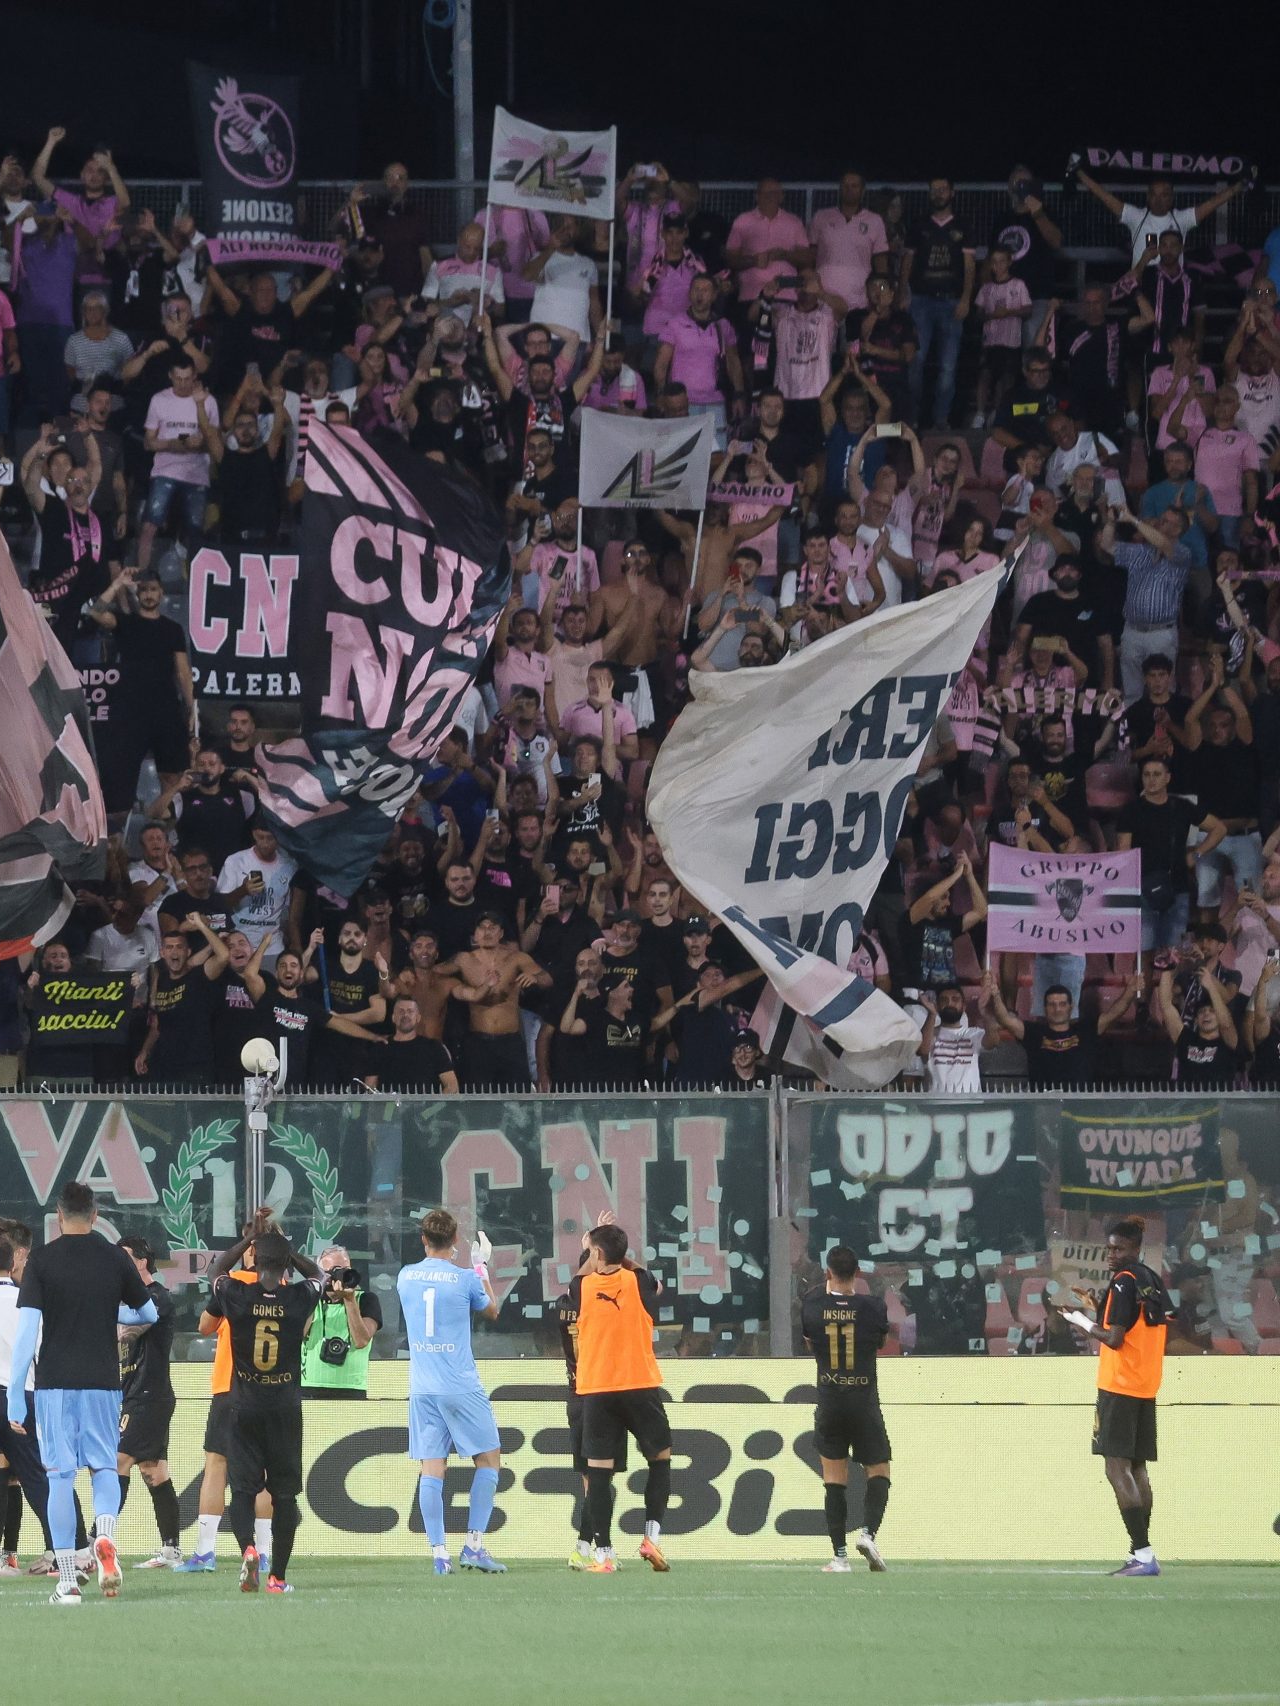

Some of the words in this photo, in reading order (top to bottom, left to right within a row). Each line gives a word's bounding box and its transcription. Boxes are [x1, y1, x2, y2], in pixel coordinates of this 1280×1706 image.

[1087, 147, 1244, 176] PALERMO
[188, 547, 300, 658] CN
[1020, 859, 1120, 882] GRUPPO
[1012, 918, 1126, 944] ABUSIVO
[44, 980, 124, 1005] Nianti
[37, 1009, 125, 1032] sacciu!
[1078, 1123, 1203, 1157] OVUNQUE
[405, 1269, 459, 1284] DESPLANCHES
[252, 1304, 285, 1317] GOMES
[422, 1287, 436, 1338] 1
[823, 1309, 857, 1320] INSIGNE
[253, 1319, 280, 1372] 6
[824, 1322, 855, 1370] 11
